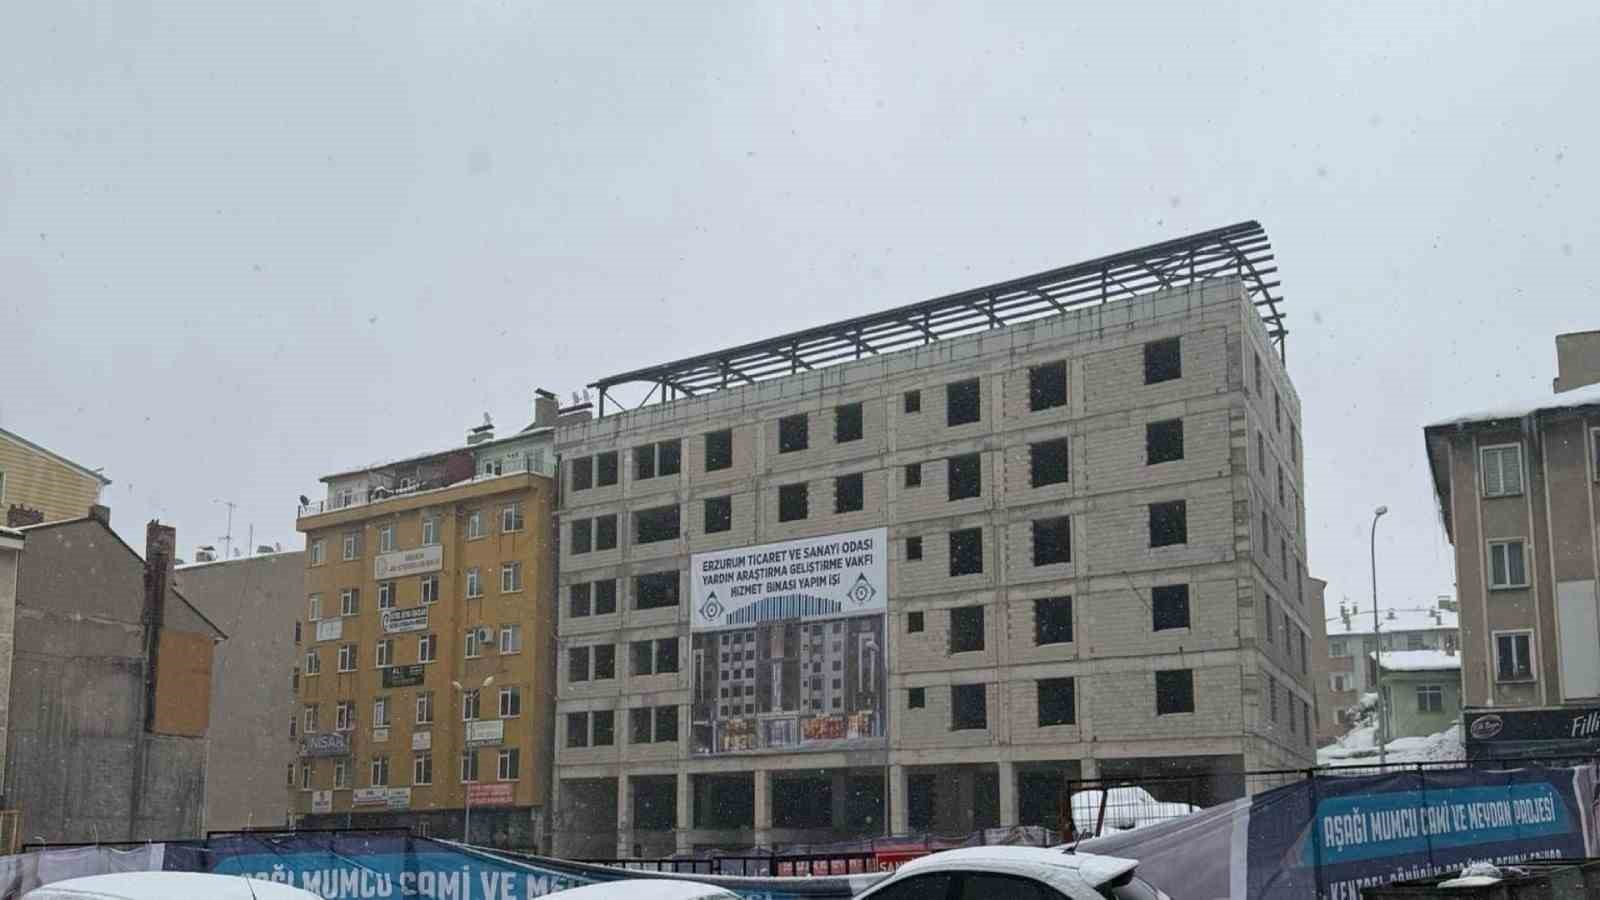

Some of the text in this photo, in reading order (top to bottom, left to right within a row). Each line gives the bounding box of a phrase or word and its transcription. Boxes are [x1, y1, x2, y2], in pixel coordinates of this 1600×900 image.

[703, 555, 746, 572] ERZURUM
[788, 548, 801, 561] VE
[842, 537, 873, 554] ODASI
[845, 553, 873, 569] VAKFI
[799, 575, 827, 589] YAPIM
[1323, 791, 1557, 853] AŞAĞI MUMCU CAMİ VE MEYDAN PROJESİ
[302, 868, 393, 899] MUMCU
[400, 864, 471, 900] CAMİ
[480, 871, 517, 900] VE
